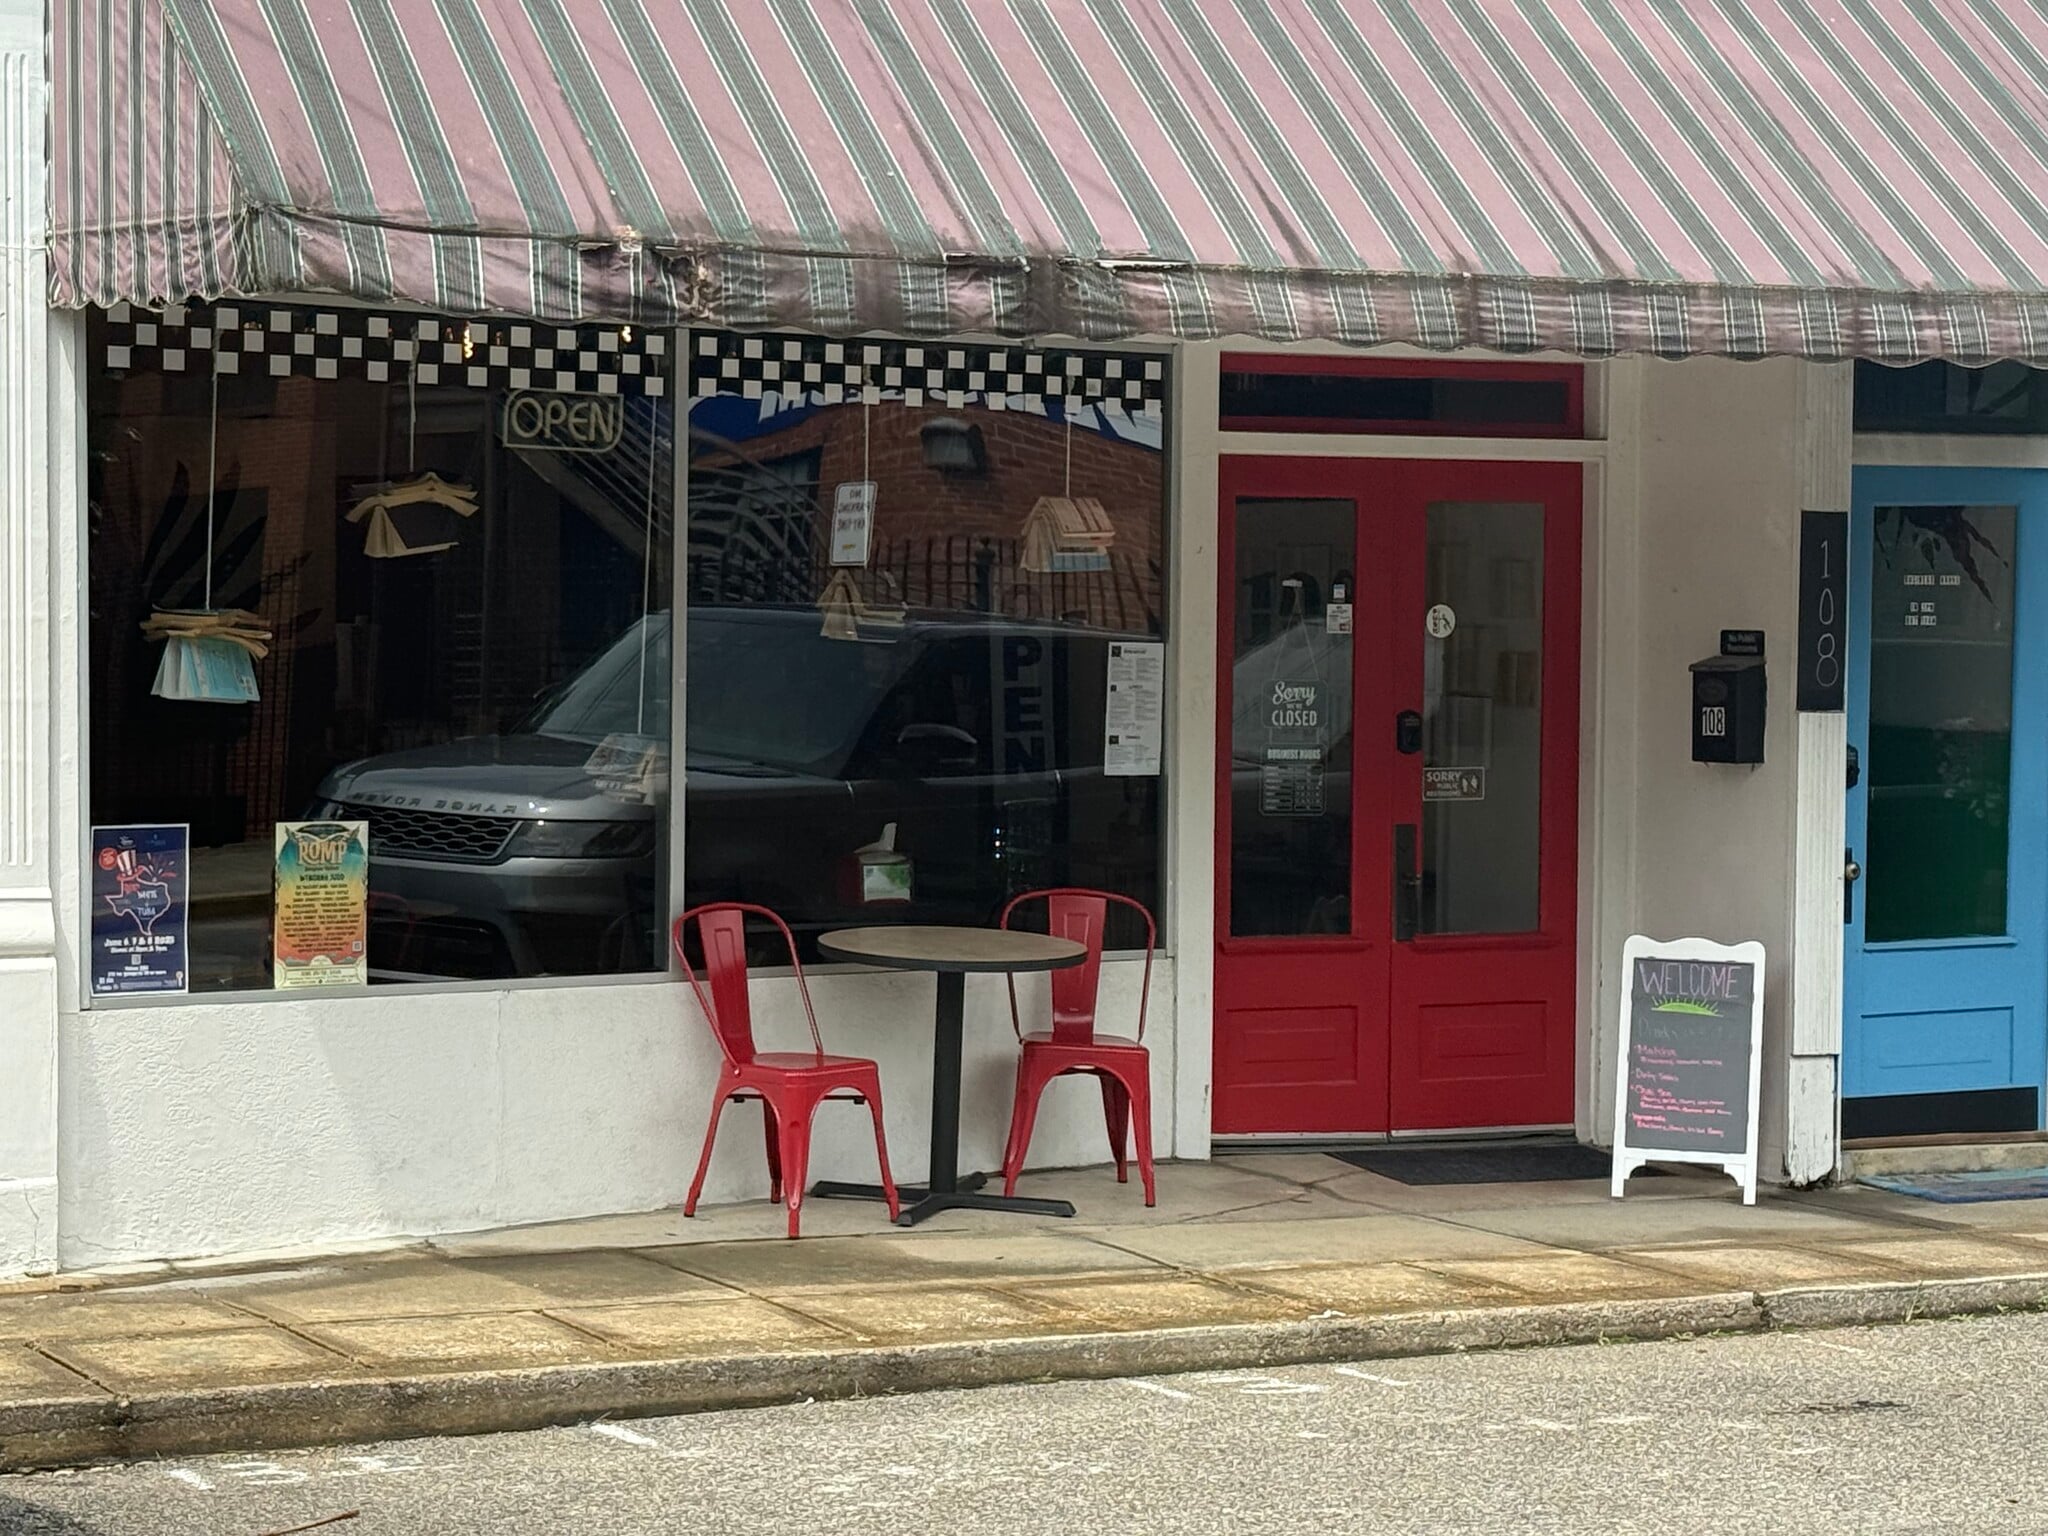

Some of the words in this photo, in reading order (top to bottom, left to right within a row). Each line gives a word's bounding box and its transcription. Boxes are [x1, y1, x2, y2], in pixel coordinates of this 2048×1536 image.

[511, 397, 615, 442] OPEN
[1816, 540, 1839, 687] 108
[1272, 681, 1317, 706] Sorry
[1272, 710, 1318, 726] CLOSED
[1703, 708, 1724, 734] 108
[1426, 771, 1462, 782] SORRY
[298, 840, 347, 865] ROMP
[1639, 963, 1741, 998] WELCOME
